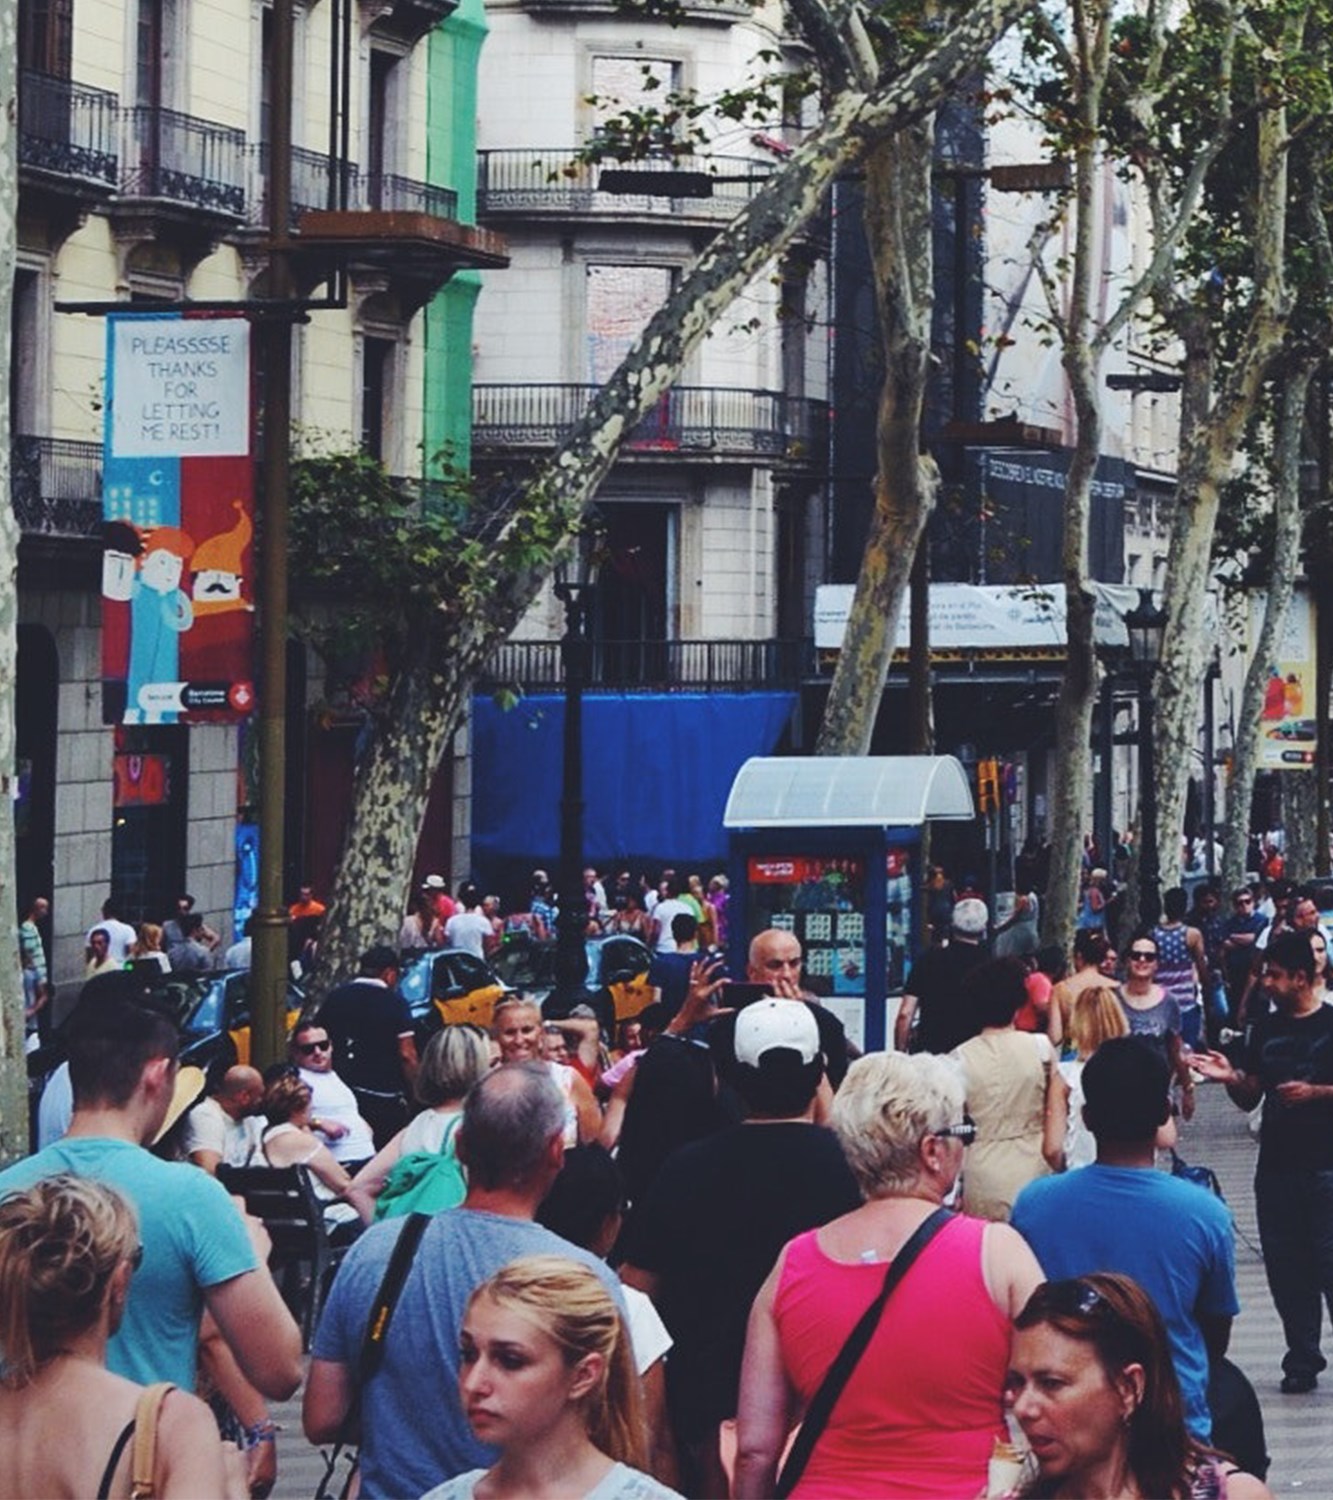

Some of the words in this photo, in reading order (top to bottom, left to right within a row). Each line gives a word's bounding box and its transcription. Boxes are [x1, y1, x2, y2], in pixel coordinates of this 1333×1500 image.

[131, 335, 232, 355] PLEASSSSE
[148, 361, 218, 378] THANKS
[164, 381, 198, 399] FOR
[141, 402, 220, 420] LETTING
[141, 424, 163, 441] ME
[169, 423, 220, 440] REST!
